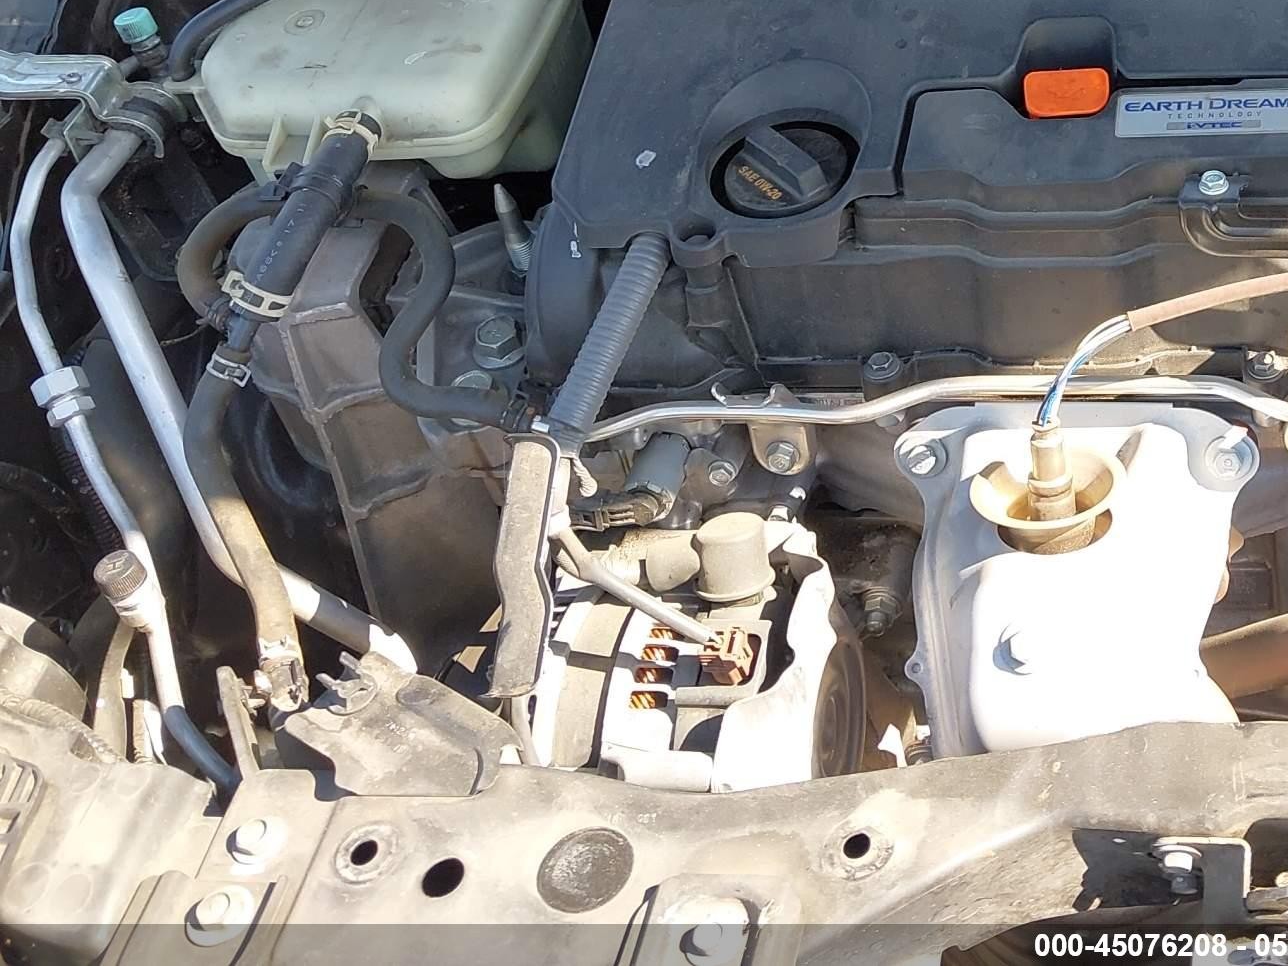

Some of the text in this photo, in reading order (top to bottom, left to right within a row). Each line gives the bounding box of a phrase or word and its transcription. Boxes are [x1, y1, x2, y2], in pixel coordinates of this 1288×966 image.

[1124, 100, 1203, 112] EARTH
[1168, 111, 1263, 119] TECHNOLOGY
[738, 165, 760, 182] SAE
